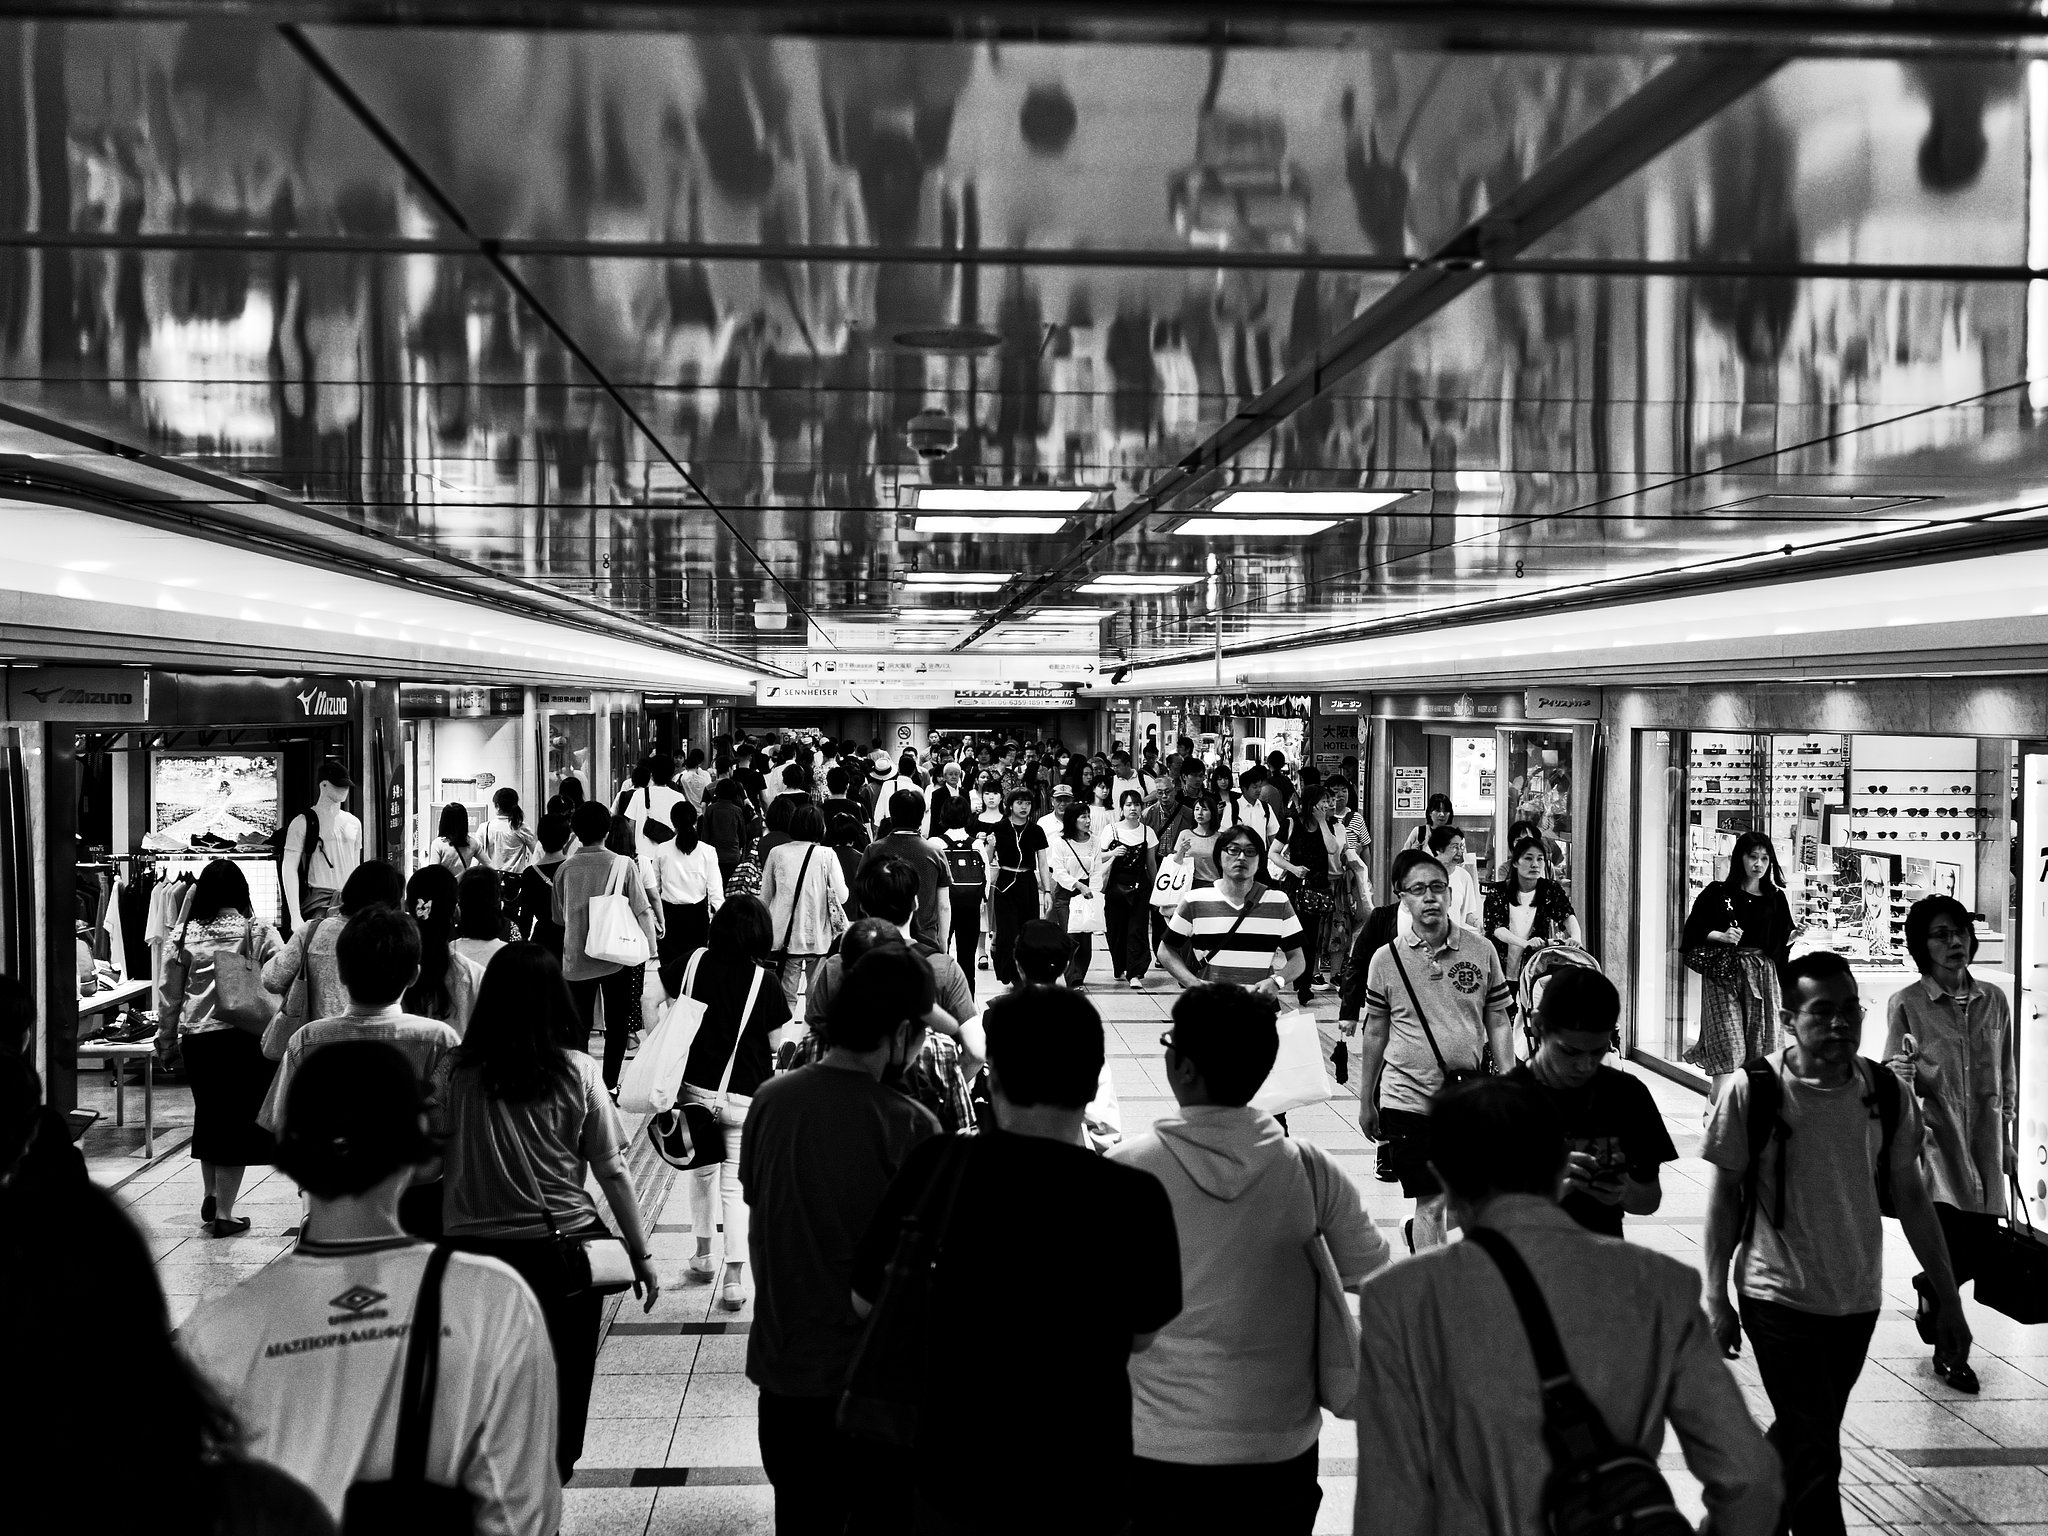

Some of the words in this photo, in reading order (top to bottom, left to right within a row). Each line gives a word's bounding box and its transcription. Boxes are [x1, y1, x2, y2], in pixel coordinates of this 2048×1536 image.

[784, 688, 838, 696] SENNHEISER
[1323, 741, 1349, 750] HOTEL
[1156, 873, 1186, 891] GU
[1448, 961, 1483, 980] SUPERDRY
[1458, 970, 1474, 982] 23
